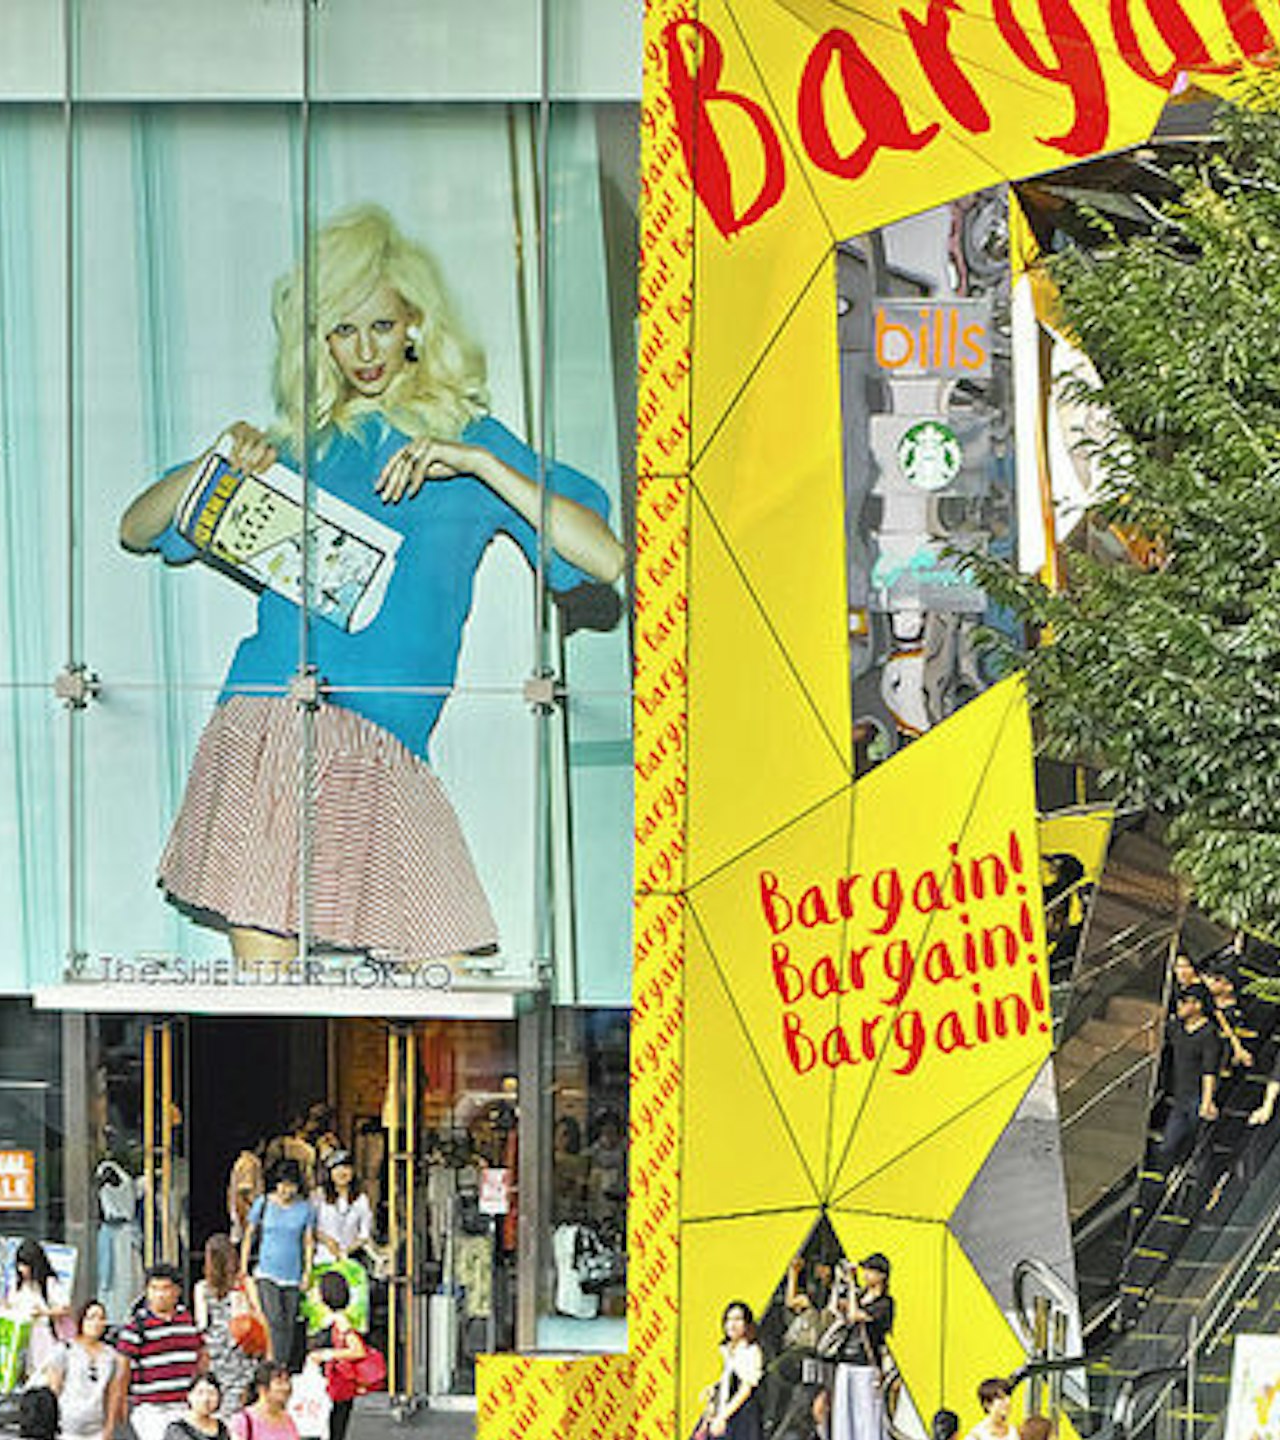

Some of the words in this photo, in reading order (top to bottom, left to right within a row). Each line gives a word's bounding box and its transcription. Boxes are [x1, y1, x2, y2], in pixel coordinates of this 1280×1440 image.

[874, 309, 986, 370] bills
[756, 828, 1030, 940] Bargain!
[768, 900, 1040, 1008] Bargain!
[780, 970, 1052, 1078] Bargain!
